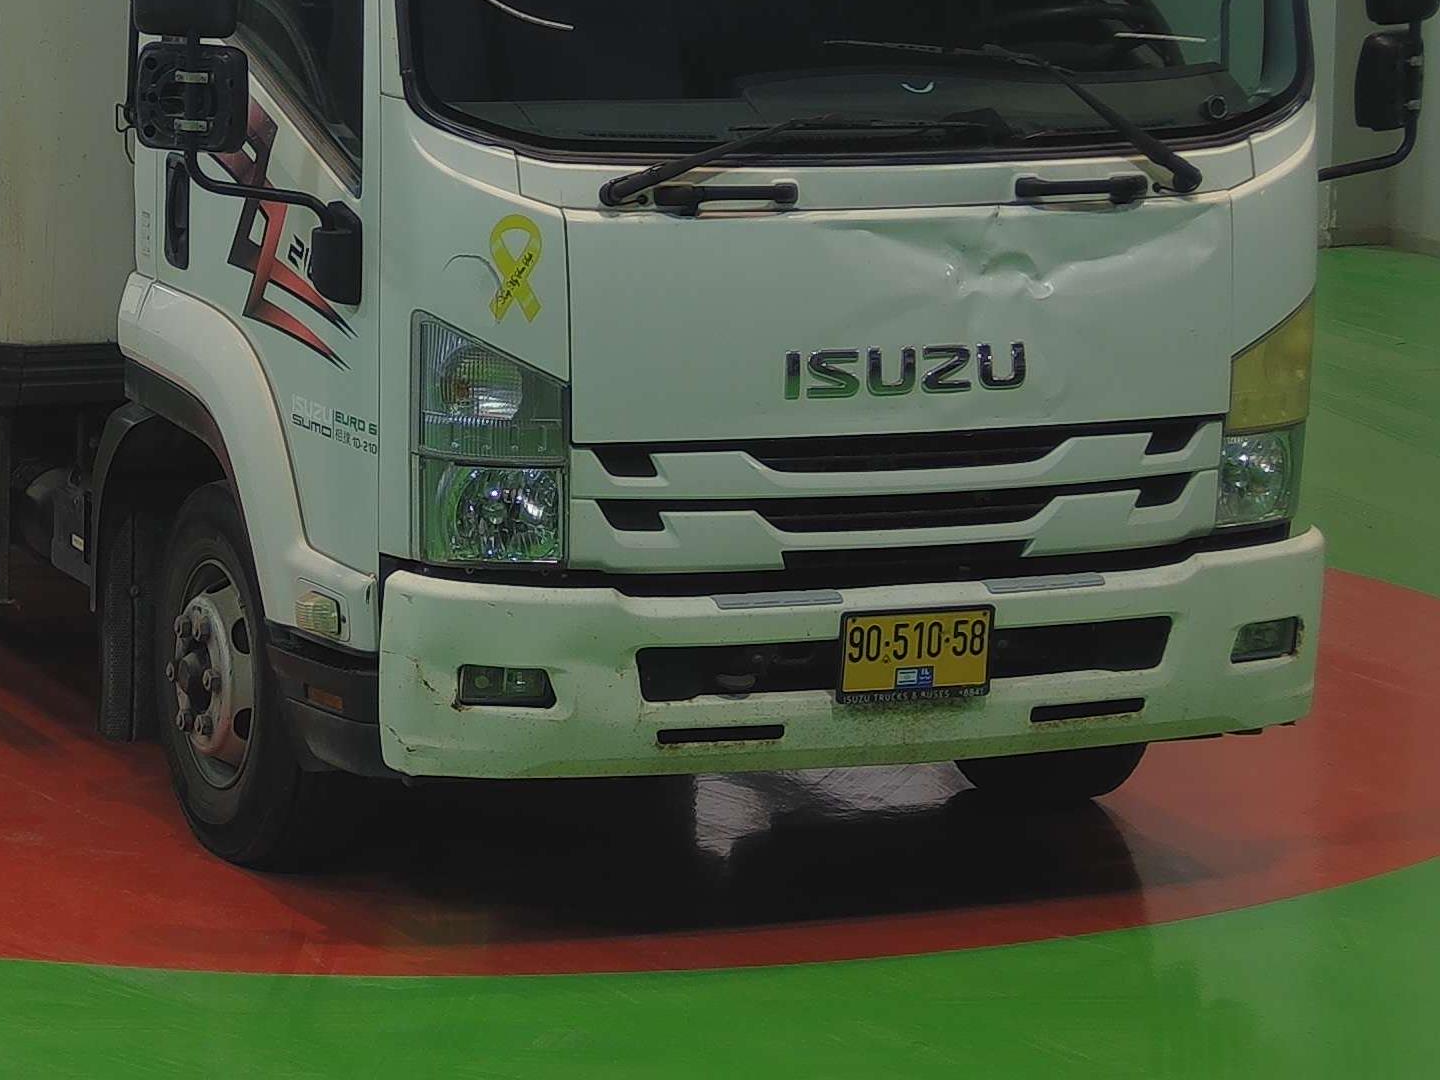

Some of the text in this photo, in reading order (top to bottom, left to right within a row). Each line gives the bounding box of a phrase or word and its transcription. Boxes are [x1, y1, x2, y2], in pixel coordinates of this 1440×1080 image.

[784, 341, 1027, 400] ISUZU
[293, 414, 331, 438] SUMO
[335, 411, 378, 436] EURO 6
[843, 694, 870, 704] ISUZU
